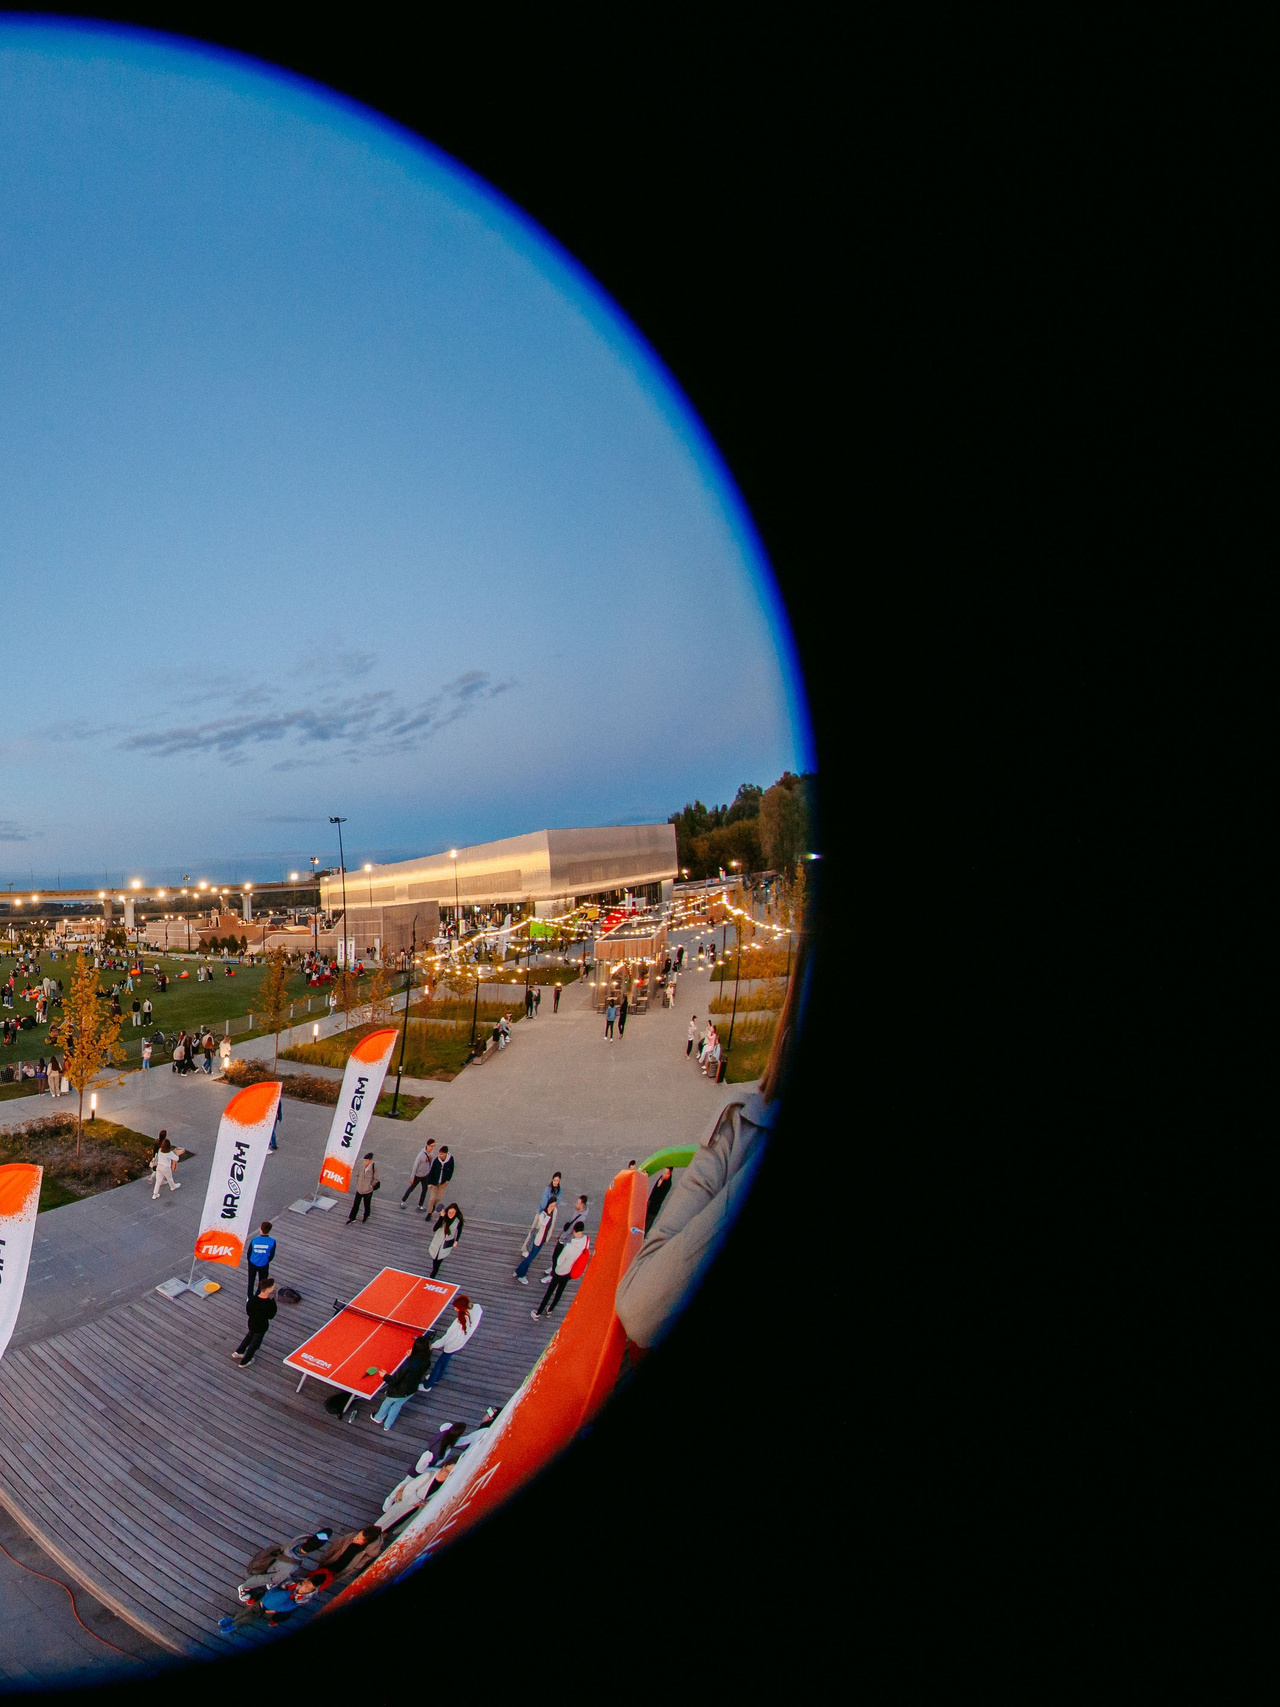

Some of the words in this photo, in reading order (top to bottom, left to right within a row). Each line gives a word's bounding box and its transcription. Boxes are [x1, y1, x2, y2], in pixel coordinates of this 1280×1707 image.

[323, 1169, 344, 1184] ПИК
[201, 1245, 234, 1257] ПИК
[423, 1283, 448, 1294] ПИК
